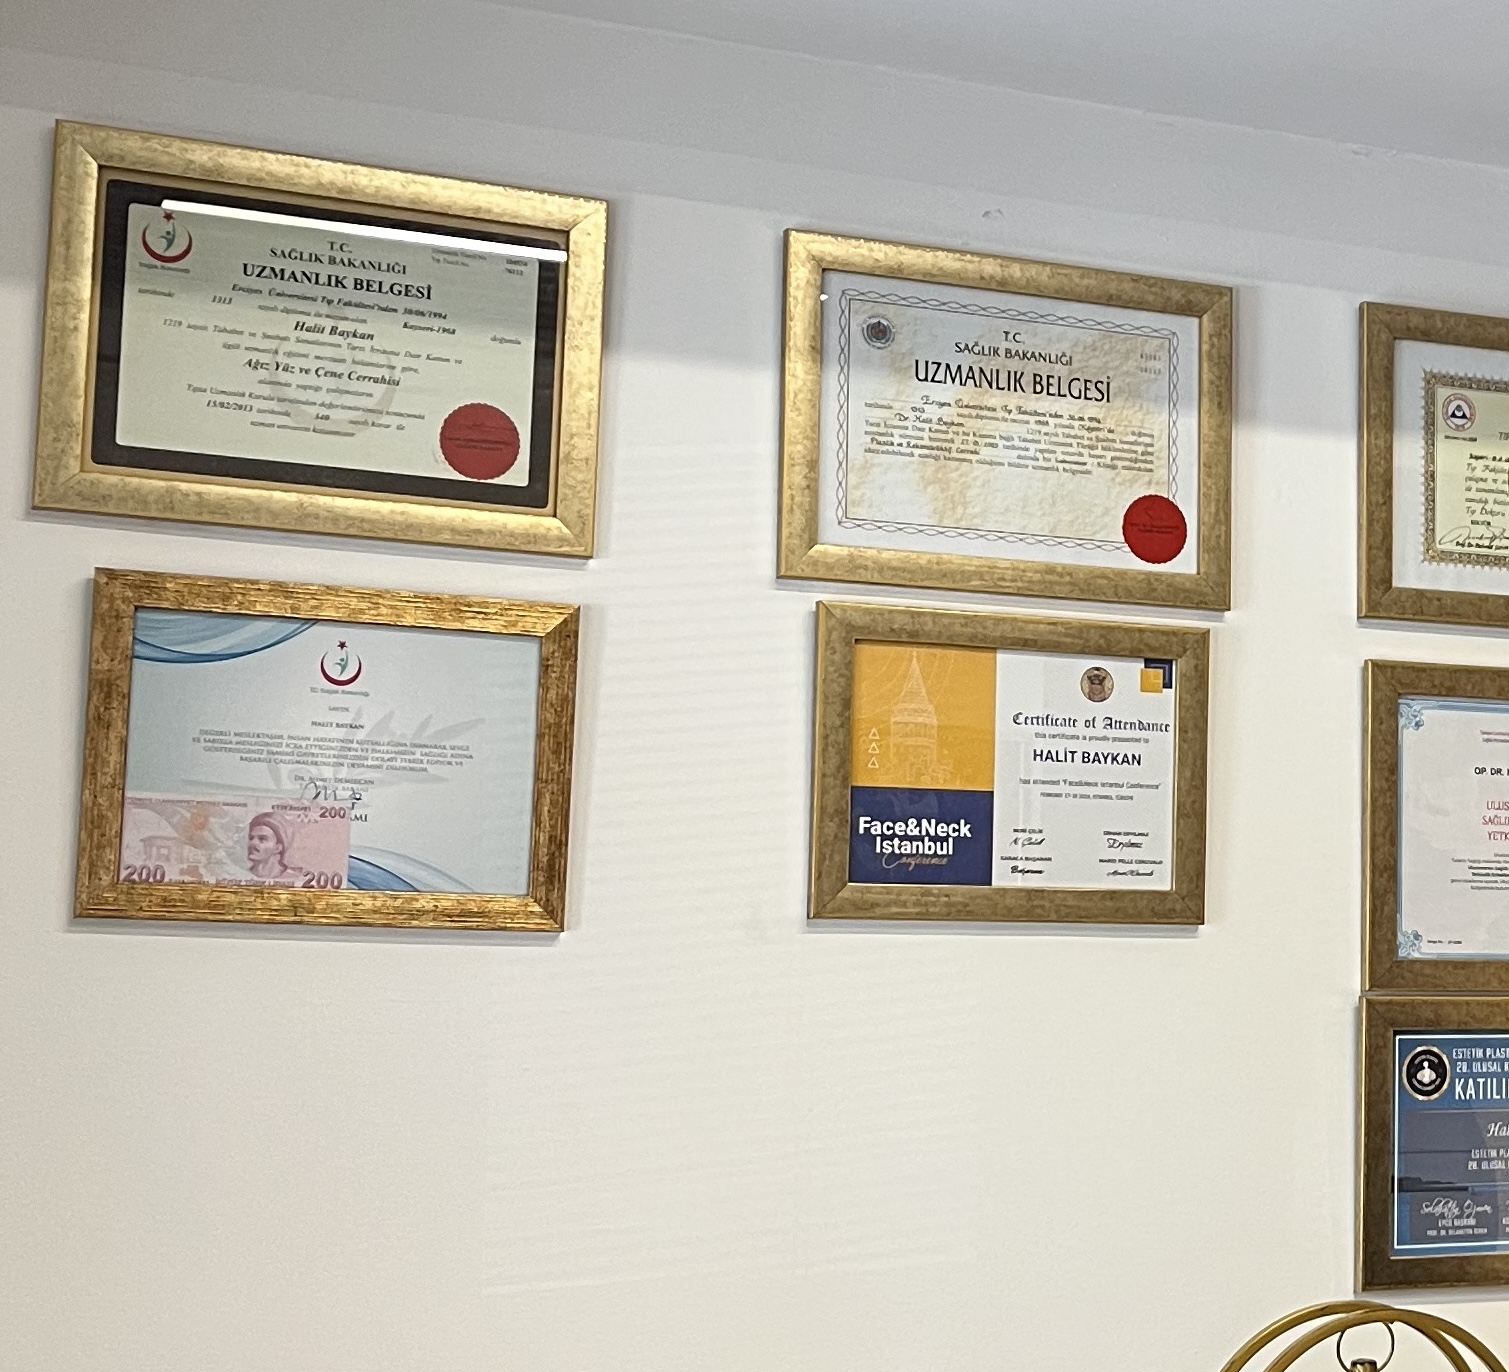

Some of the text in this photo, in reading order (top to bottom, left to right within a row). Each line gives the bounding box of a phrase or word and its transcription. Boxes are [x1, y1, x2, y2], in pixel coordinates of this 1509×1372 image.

[327, 241, 353, 254] T.C.
[269, 247, 407, 275] SAĞLIK BAKANLIĞI
[242, 262, 433, 300] UZMANLIK BELGESİ
[294, 320, 375, 342] Halit Baykan
[1003, 330, 1025, 344] T.C.
[954, 341, 1073, 366] SAĞLIK BAKANLIĞI
[274, 360, 295, 374] Yüz
[299, 366, 312, 376] ve
[314, 366, 344, 380] Çene
[348, 371, 401, 387] Cerrahisi
[914, 359, 1111, 403] UZMANLIK BELGESİ
[1012, 711, 1171, 733] Certificate of Attendance
[1033, 746, 1142, 767] HALİT BAYKAN
[1490, 767, 1504, 777] DR.
[319, 806, 346, 820] 200
[858, 816, 972, 838] Face&Neck
[875, 836, 954, 855] Istanbul
[122, 863, 166, 884] 200
[302, 870, 343, 890] 200
